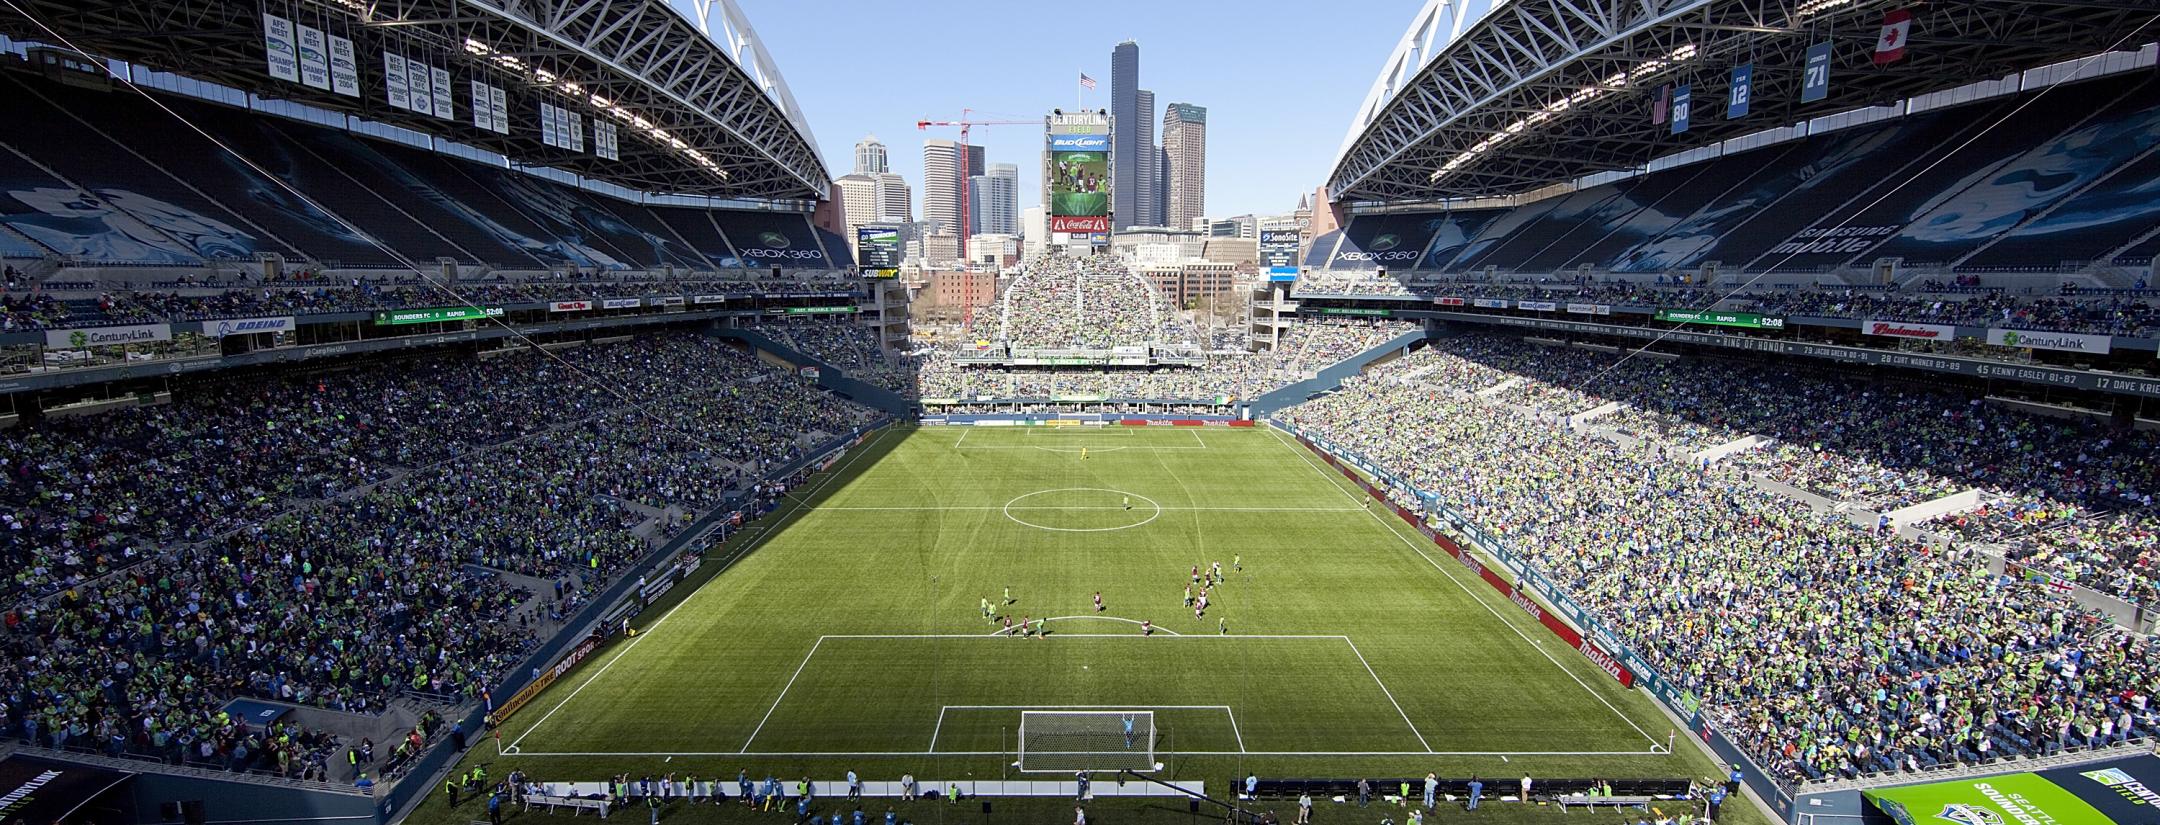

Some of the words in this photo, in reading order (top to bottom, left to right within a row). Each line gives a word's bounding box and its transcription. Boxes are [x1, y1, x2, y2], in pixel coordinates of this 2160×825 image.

[272, 19, 285, 29] AFC
[271, 26, 288, 38] WEST
[306, 30, 317, 39] AFC
[304, 37, 320, 48] WEST
[334, 40, 347, 49] NFC
[334, 47, 350, 57] WEST
[270, 55, 295, 68] CHAMPS
[389, 62, 402, 72] WEST
[303, 64, 327, 76] CHAMPS
[1807, 64, 1825, 88] 71
[1732, 84, 1747, 106] 12
[1674, 103, 1688, 122] 80
[1053, 114, 1107, 126] CENTURYLINK
[1270, 232, 1298, 241] SonoSite
[1799, 225, 1899, 238] SAMSUNG
[1772, 238, 1872, 253] mobile
[738, 248, 790, 258] XBOX
[790, 250, 822, 259] 360
[1336, 252, 1384, 261] XBOX
[1384, 250, 1418, 260] 360
[862, 269, 897, 277] SUBWAY
[235, 319, 286, 331] BOEING
[1761, 318, 1783, 327] 52:08
[90, 330, 154, 344] CenturyLink
[1872, 323, 1939, 338] Budweiser
[1723, 338, 1740, 348] RING
[1744, 340, 1753, 348] OF
[1758, 341, 1784, 352] HONOR
[2019, 335, 2084, 349] CenturyLink
[1831, 349, 1847, 358] GREEN
[1881, 355, 1891, 363] 28
[1894, 356, 1909, 365] CURT
[1911, 358, 1933, 367] WARNER
[1936, 361, 1960, 371] 83-89
[1976, 364, 1989, 374] 45
[1992, 367, 2016, 377] KENNY
[2019, 370, 2046, 381] EASLEY
[2049, 374, 2076, 384] 81-87
[2097, 378, 2108, 388] 17
[2114, 380, 2135, 391] DAVE
[1458, 550, 1482, 576] makita
[1509, 588, 1541, 621] makita
[555, 652, 577, 677] ROOT
[577, 641, 596, 660] SPOR
[1578, 640, 1620, 681] makita
[496, 686, 534, 722] Continental
[540, 671, 554, 687] TIRE
[0, 770, 64, 810] NTURYLINK
[2109, 784, 2146, 805] FIELD
